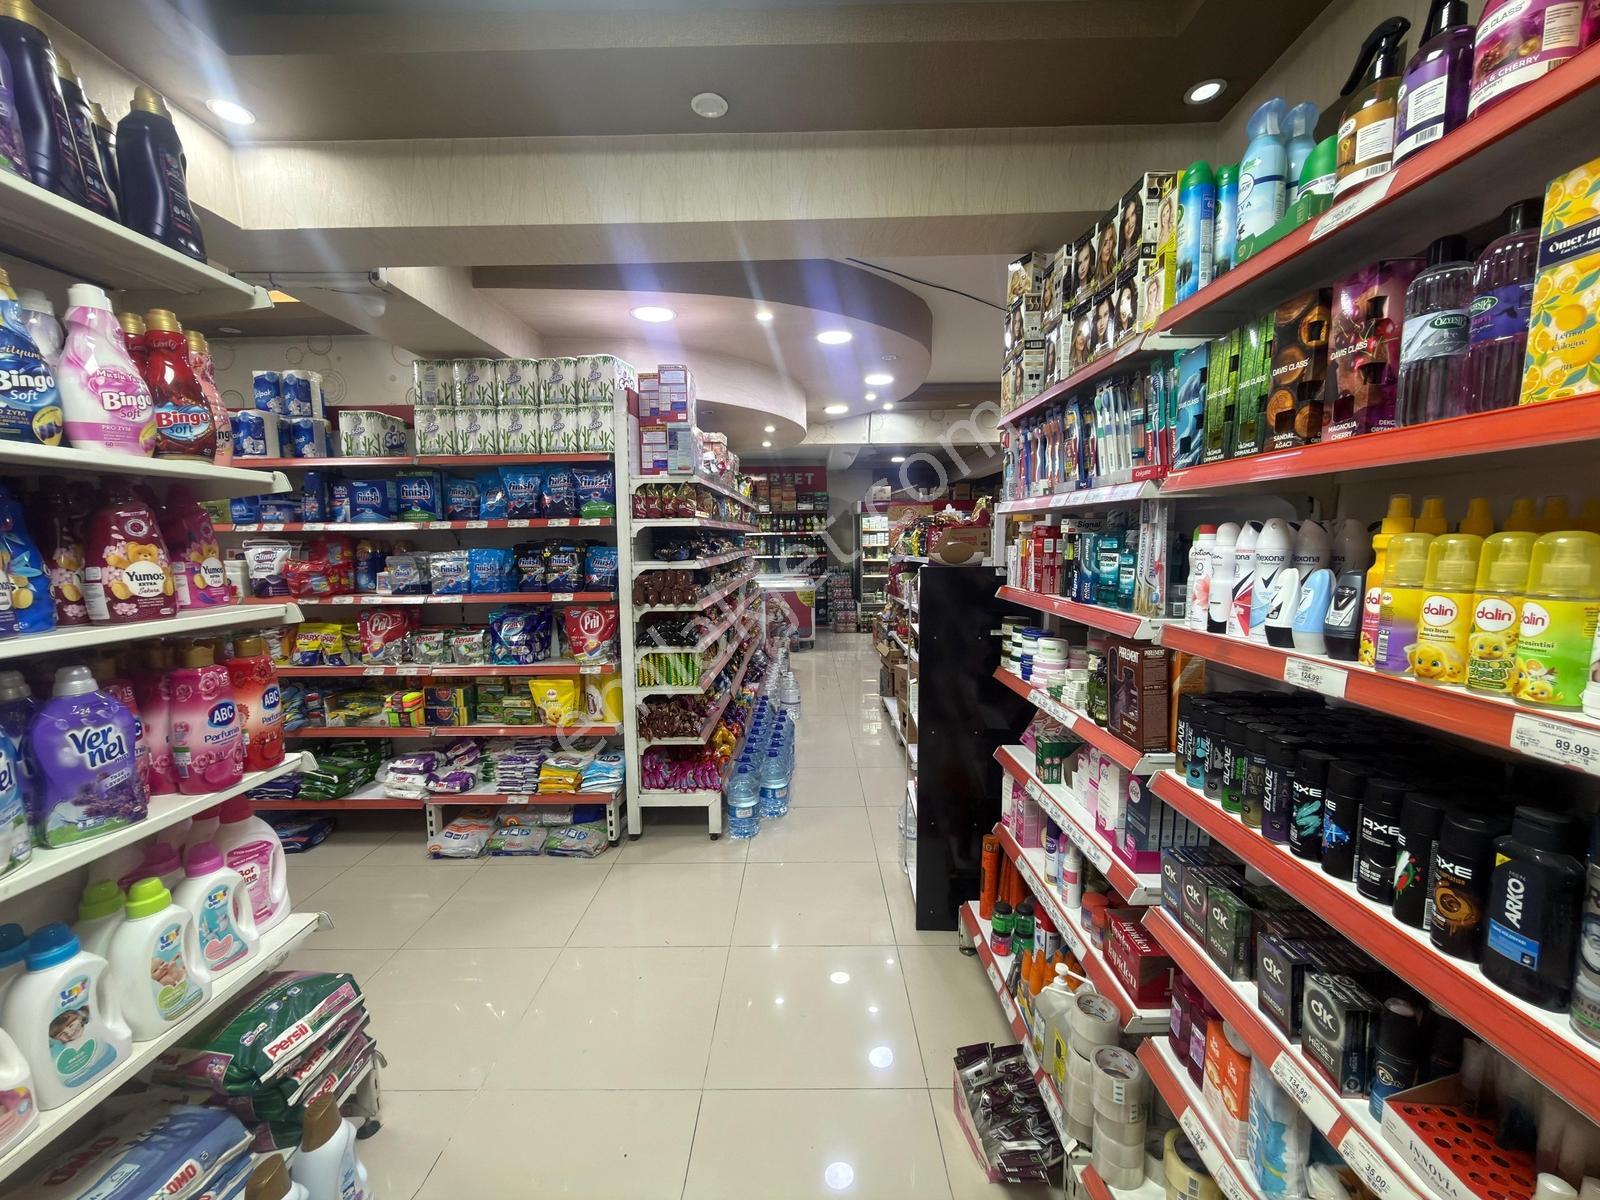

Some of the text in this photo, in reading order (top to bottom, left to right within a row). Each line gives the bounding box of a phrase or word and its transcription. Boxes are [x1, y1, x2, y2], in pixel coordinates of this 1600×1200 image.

[1498, 55, 1540, 77] CHERRY
[1348, 340, 1368, 354] CLASS
[1272, 358, 1309, 377] DAVIS CLASS
[0, 369, 55, 393] Bingo
[10, 389, 39, 403] Soft
[101, 391, 152, 411] Bingo
[120, 409, 141, 420] Soft
[156, 411, 209, 428] Bingo
[1328, 420, 1357, 433] MAGNOLIA
[1331, 430, 1353, 441] CHERRY
[356, 491, 380, 504] finish
[401, 486, 430, 498] finish
[1077, 521, 1101, 532] Signal
[1256, 554, 1285, 562] Rexona
[440, 565, 462, 574] finish
[1423, 603, 1454, 617] dalin
[1476, 607, 1512, 621] dalin
[584, 615, 600, 630] Pril
[219, 671, 230, 683] 15
[264, 690, 280, 706] ABC
[213, 704, 235, 723] ABC
[68, 726, 113, 754] Ver
[1177, 720, 1185, 754] BLADE
[1186, 727, 1194, 762] BLADE
[88, 734, 126, 768] nel
[1555, 738, 1591, 756] 89.99
[1222, 745, 1232, 786] BLADE
[1263, 767, 1273, 812] BLADE
[1293, 781, 1322, 797] AXE
[1363, 816, 1401, 836] AXE
[1436, 854, 1473, 880] AXE
[1504, 877, 1526, 929] ARKO
[267, 1022, 310, 1058] Persil
[1287, 1075, 1309, 1099] 134.99
[166, 1164, 198, 1196] OMO
[1364, 1162, 1388, 1188] 35.00
